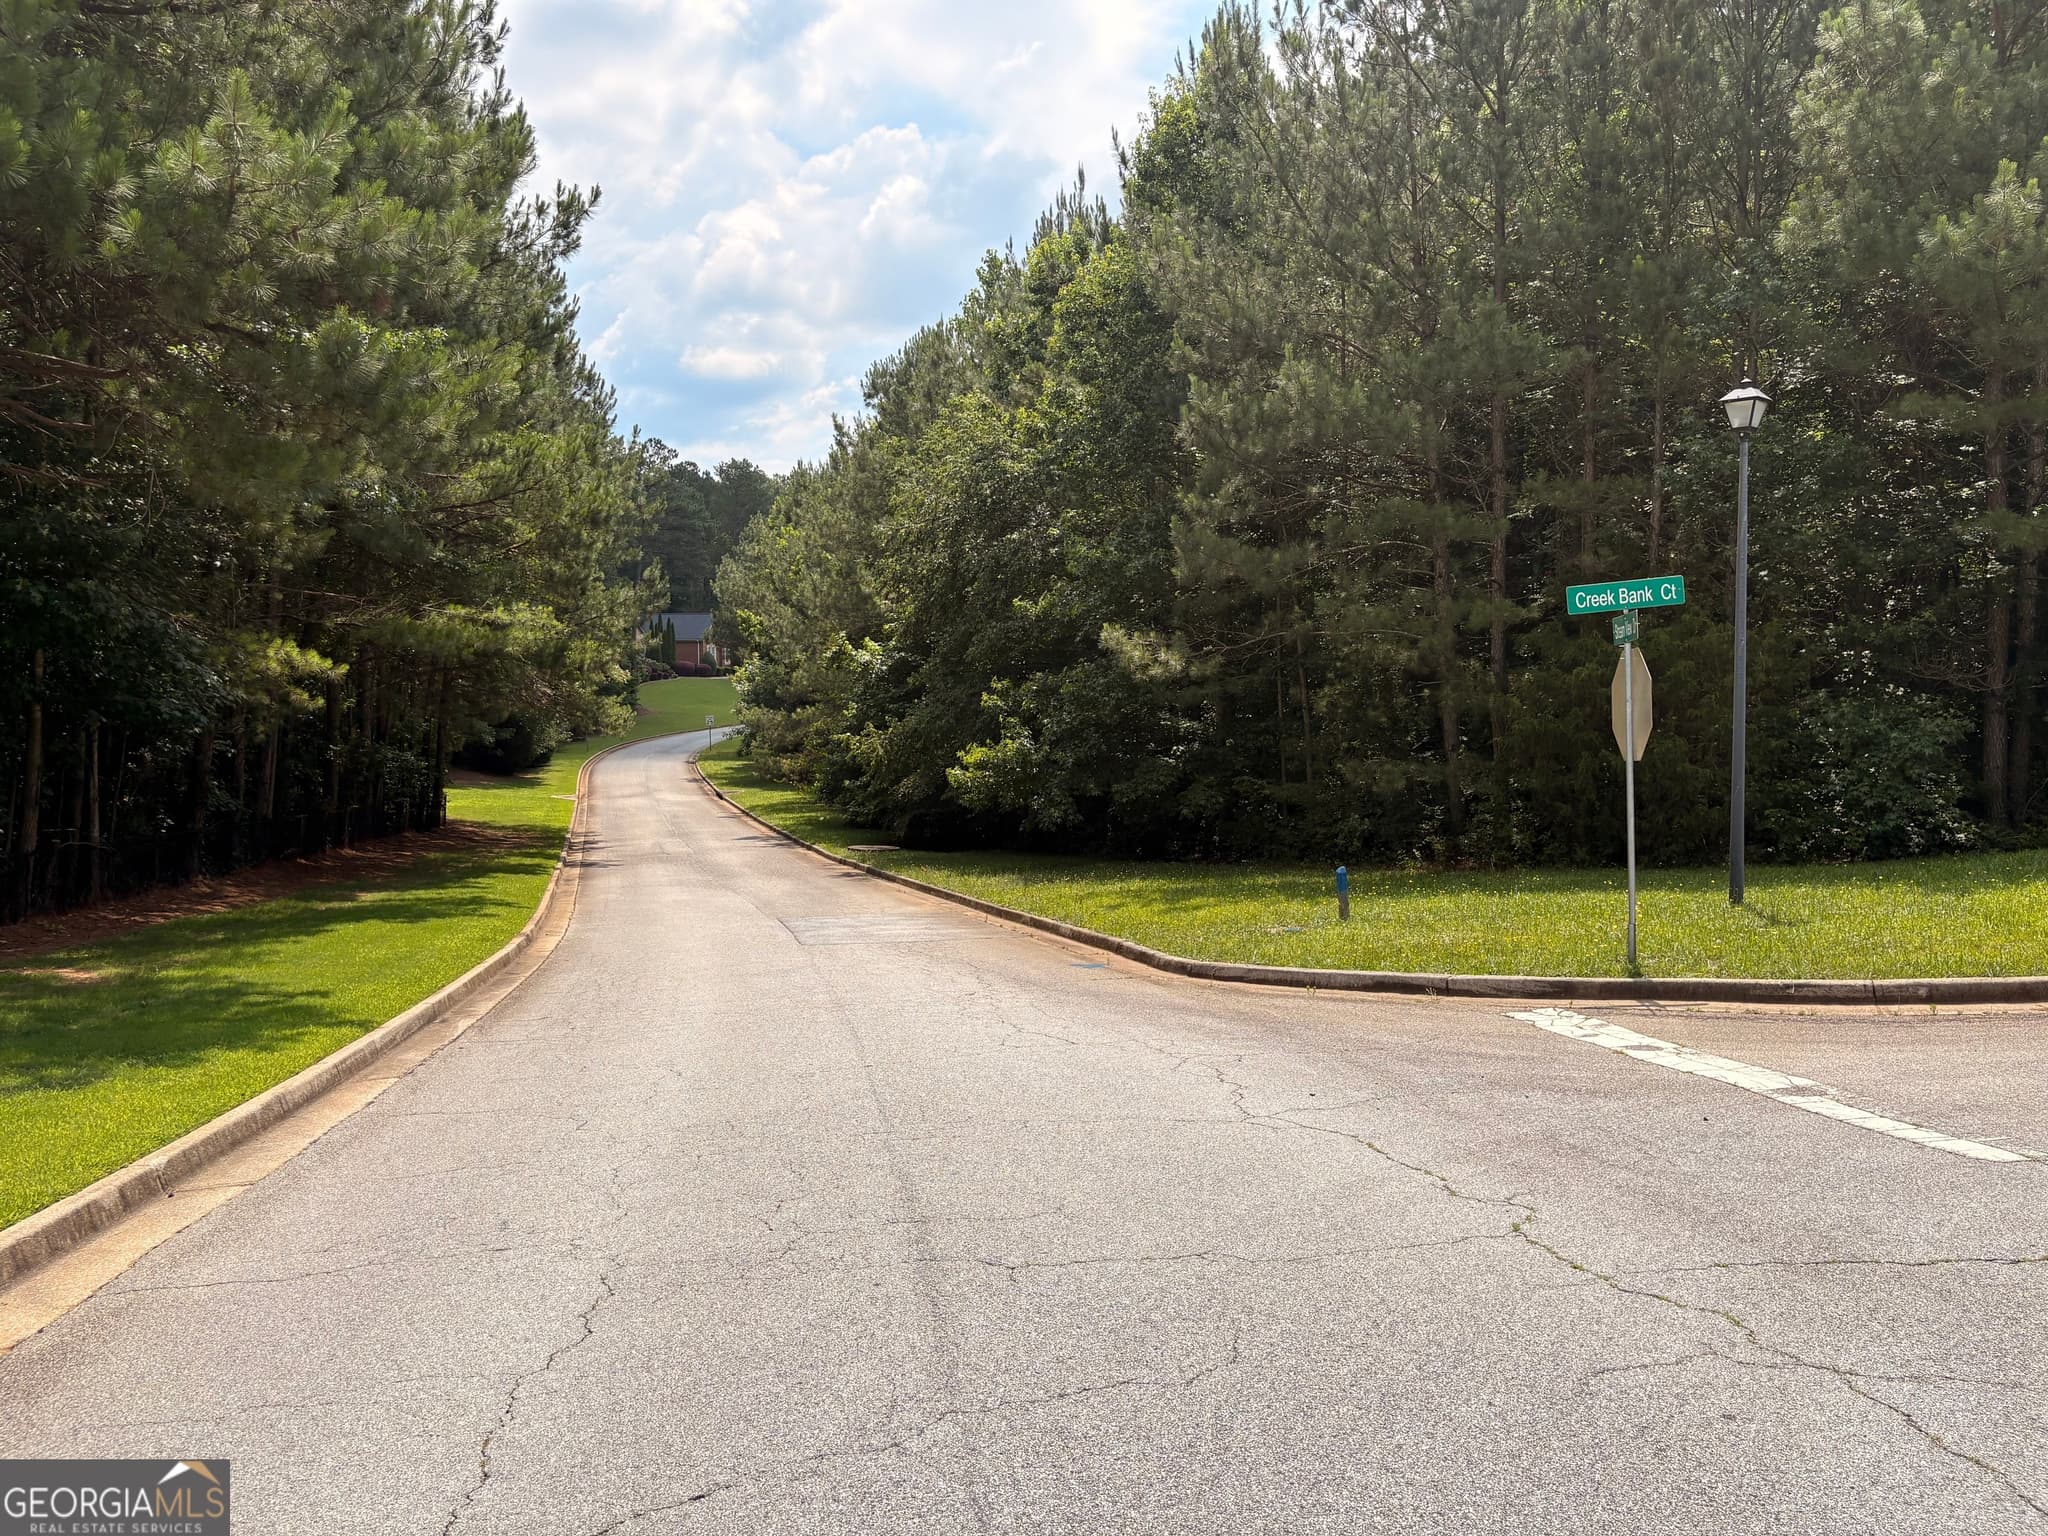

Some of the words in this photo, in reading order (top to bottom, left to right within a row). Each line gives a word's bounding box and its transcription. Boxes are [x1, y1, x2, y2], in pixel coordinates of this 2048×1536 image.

[1575, 590, 1616, 608] Creek
[1618, 586, 1654, 604] Bank
[1660, 583, 1677, 600] Ct
